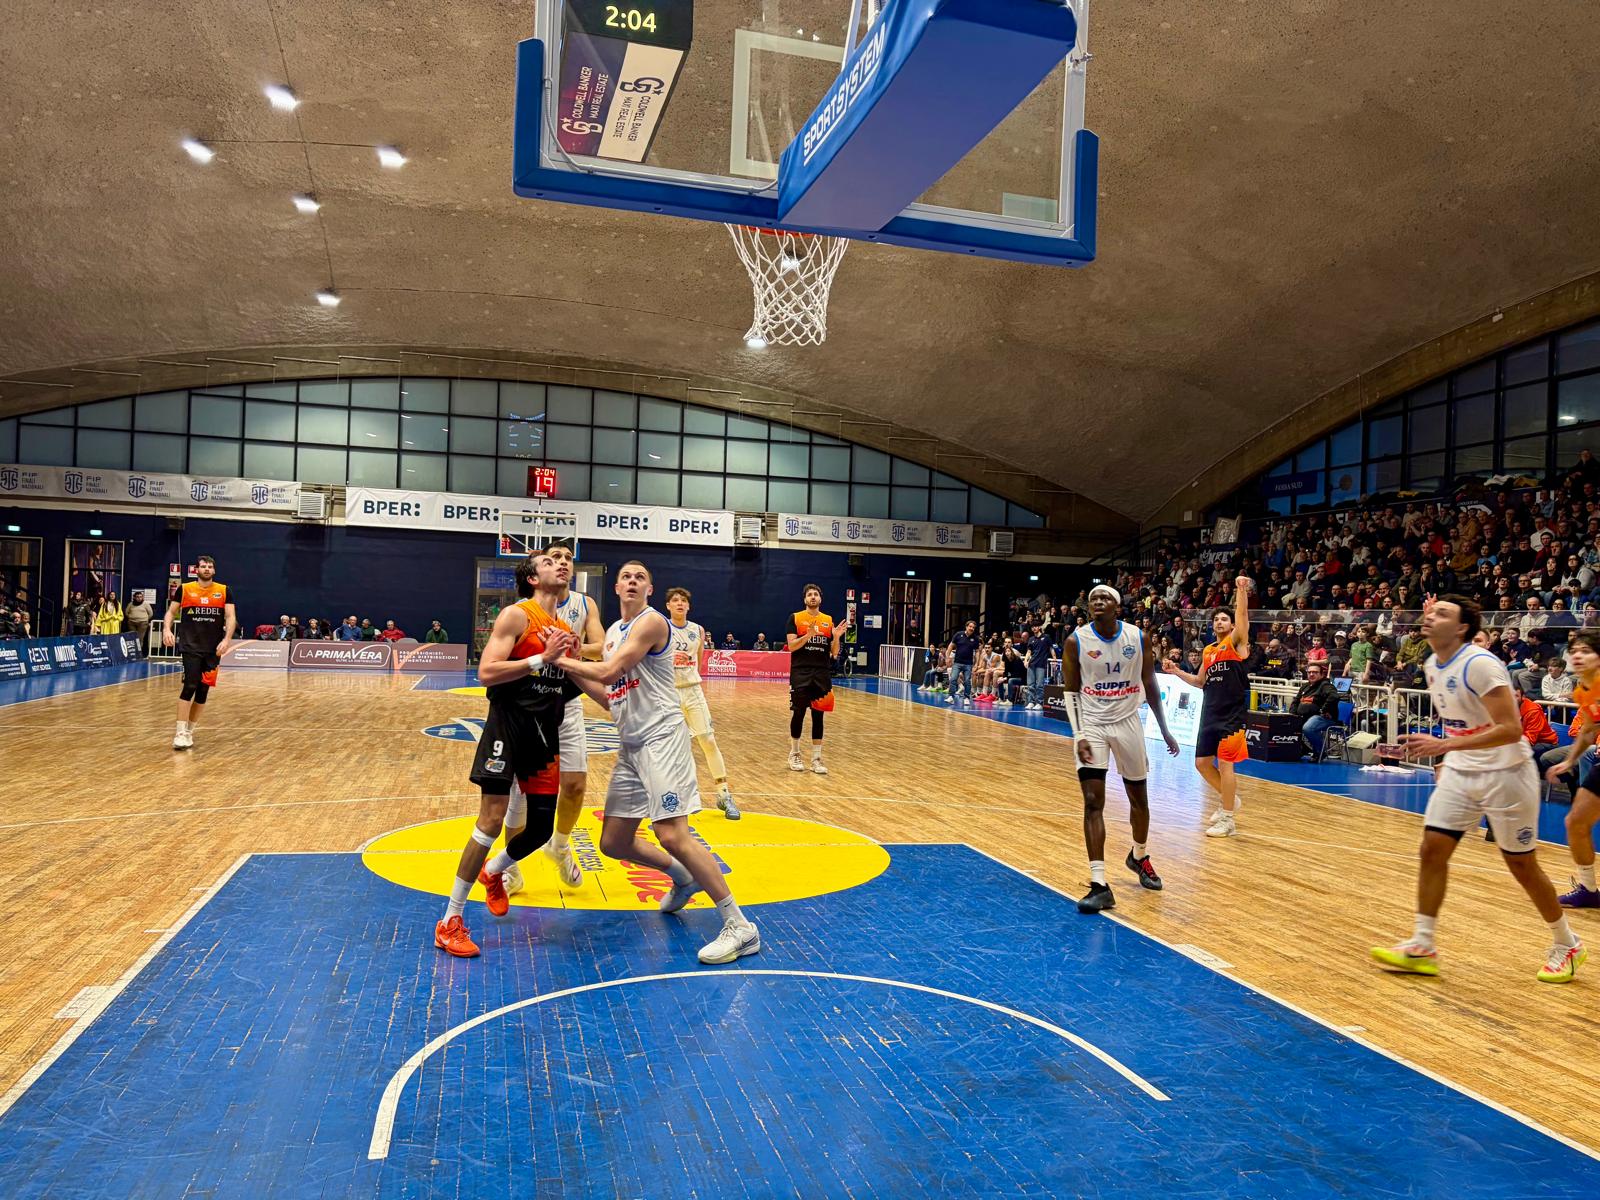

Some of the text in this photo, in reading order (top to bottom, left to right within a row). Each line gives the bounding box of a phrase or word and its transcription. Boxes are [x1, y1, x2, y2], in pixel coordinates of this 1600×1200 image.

[605, 5, 657, 33] 2:04
[595, 73, 609, 93] ESTATE
[803, 22, 886, 157] SPORTSYSTEM
[572, 66, 593, 119] COLDWELL BANKER
[628, 96, 651, 142] COLDWELL BANKER
[613, 122, 626, 138] ESTATE
[534, 467, 555, 477] 2:04
[536, 476, 554, 493] 19
[363, 500, 421, 517] BPER:
[443, 505, 500, 522] BPER:
[596, 514, 649, 531] BPER:
[669, 518, 719, 535] BPER:
[195, 607, 221, 616] REDEL
[299, 648, 383, 660] LA PRIMAVERA
[675, 641, 689, 652] 22
[1105, 661, 1121, 675] 14
[1047, 696, 1067, 707] C-H
[492, 740, 504, 757] 9
